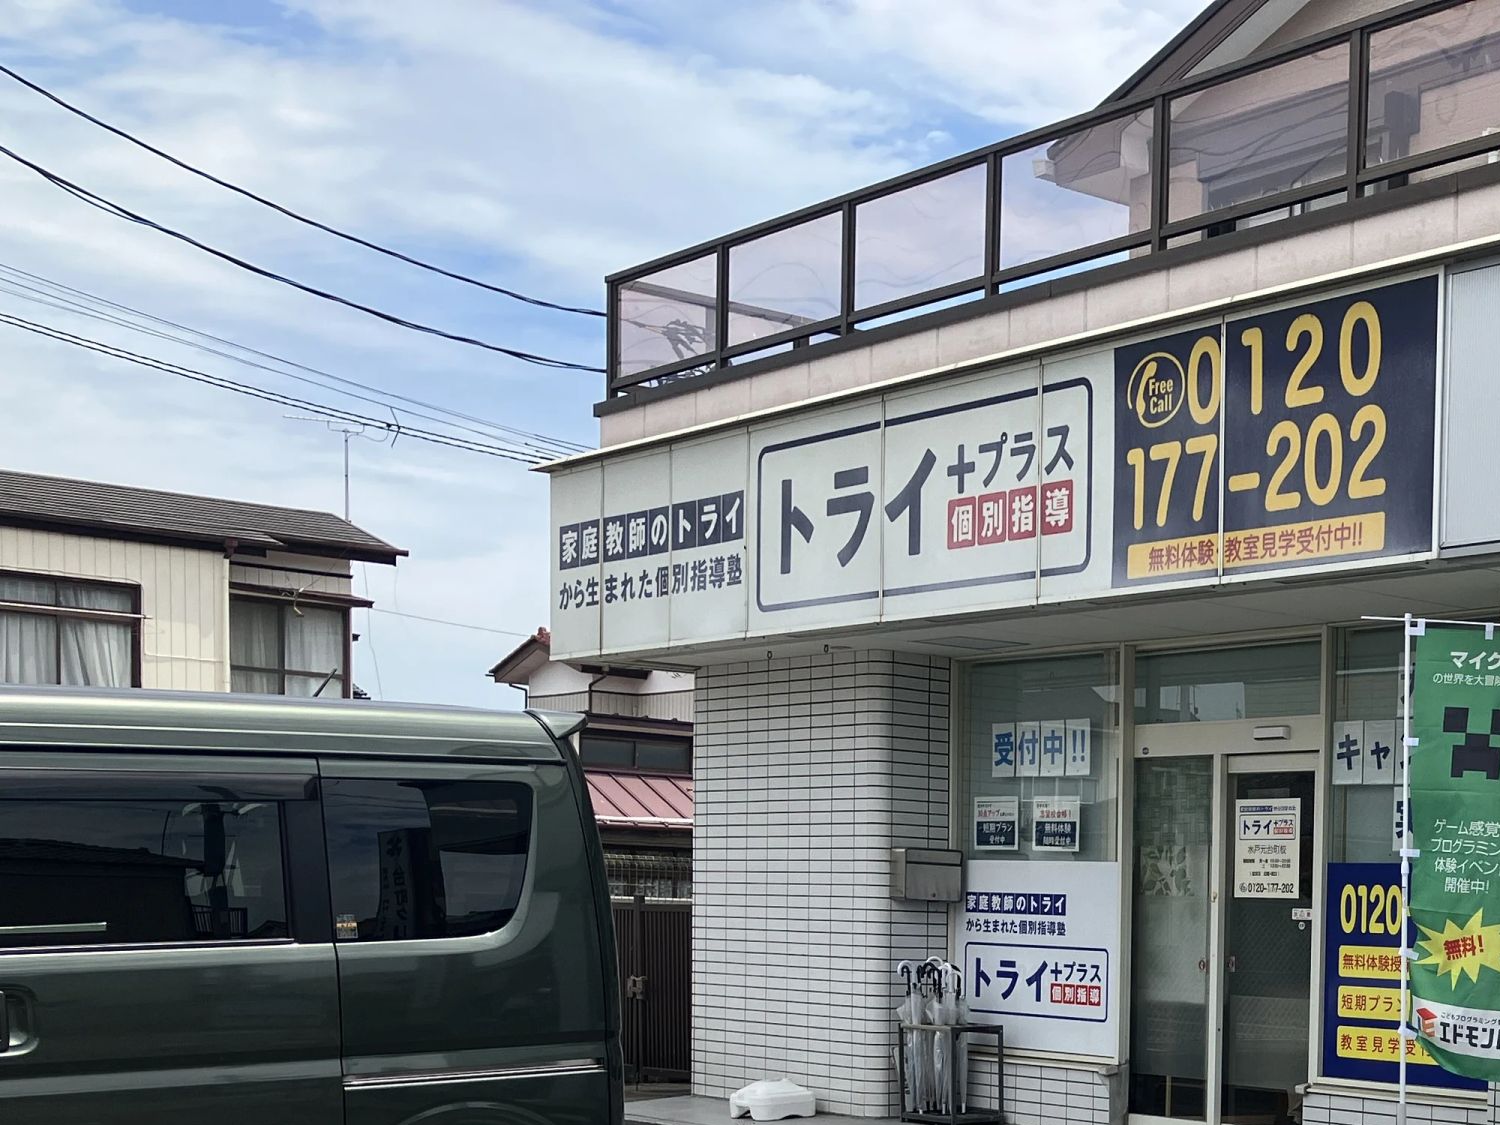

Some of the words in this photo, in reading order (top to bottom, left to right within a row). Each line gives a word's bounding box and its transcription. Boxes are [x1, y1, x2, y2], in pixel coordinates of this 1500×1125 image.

[1187, 301, 1382, 425] 0120
[1148, 377, 1174, 395] Free
[1149, 396, 1174, 414] Call
[1127, 404, 1387, 530] 177-202
[561, 494, 742, 565] 家庭教師のトライ
[780, 448, 937, 575] トライ
[950, 487, 1071, 546] 個別指導
[559, 554, 742, 611] から生まれた個別指導塾
[994, 729, 1086, 768] 受付中!!
[966, 893, 1066, 916] 家庭教師のトライ
[1445, 876, 1490, 894] 開催中!
[966, 919, 1066, 936] から生まれた個別指導塾
[975, 957, 1048, 1002] トライ
[1051, 985, 1101, 1005] 個別指導
